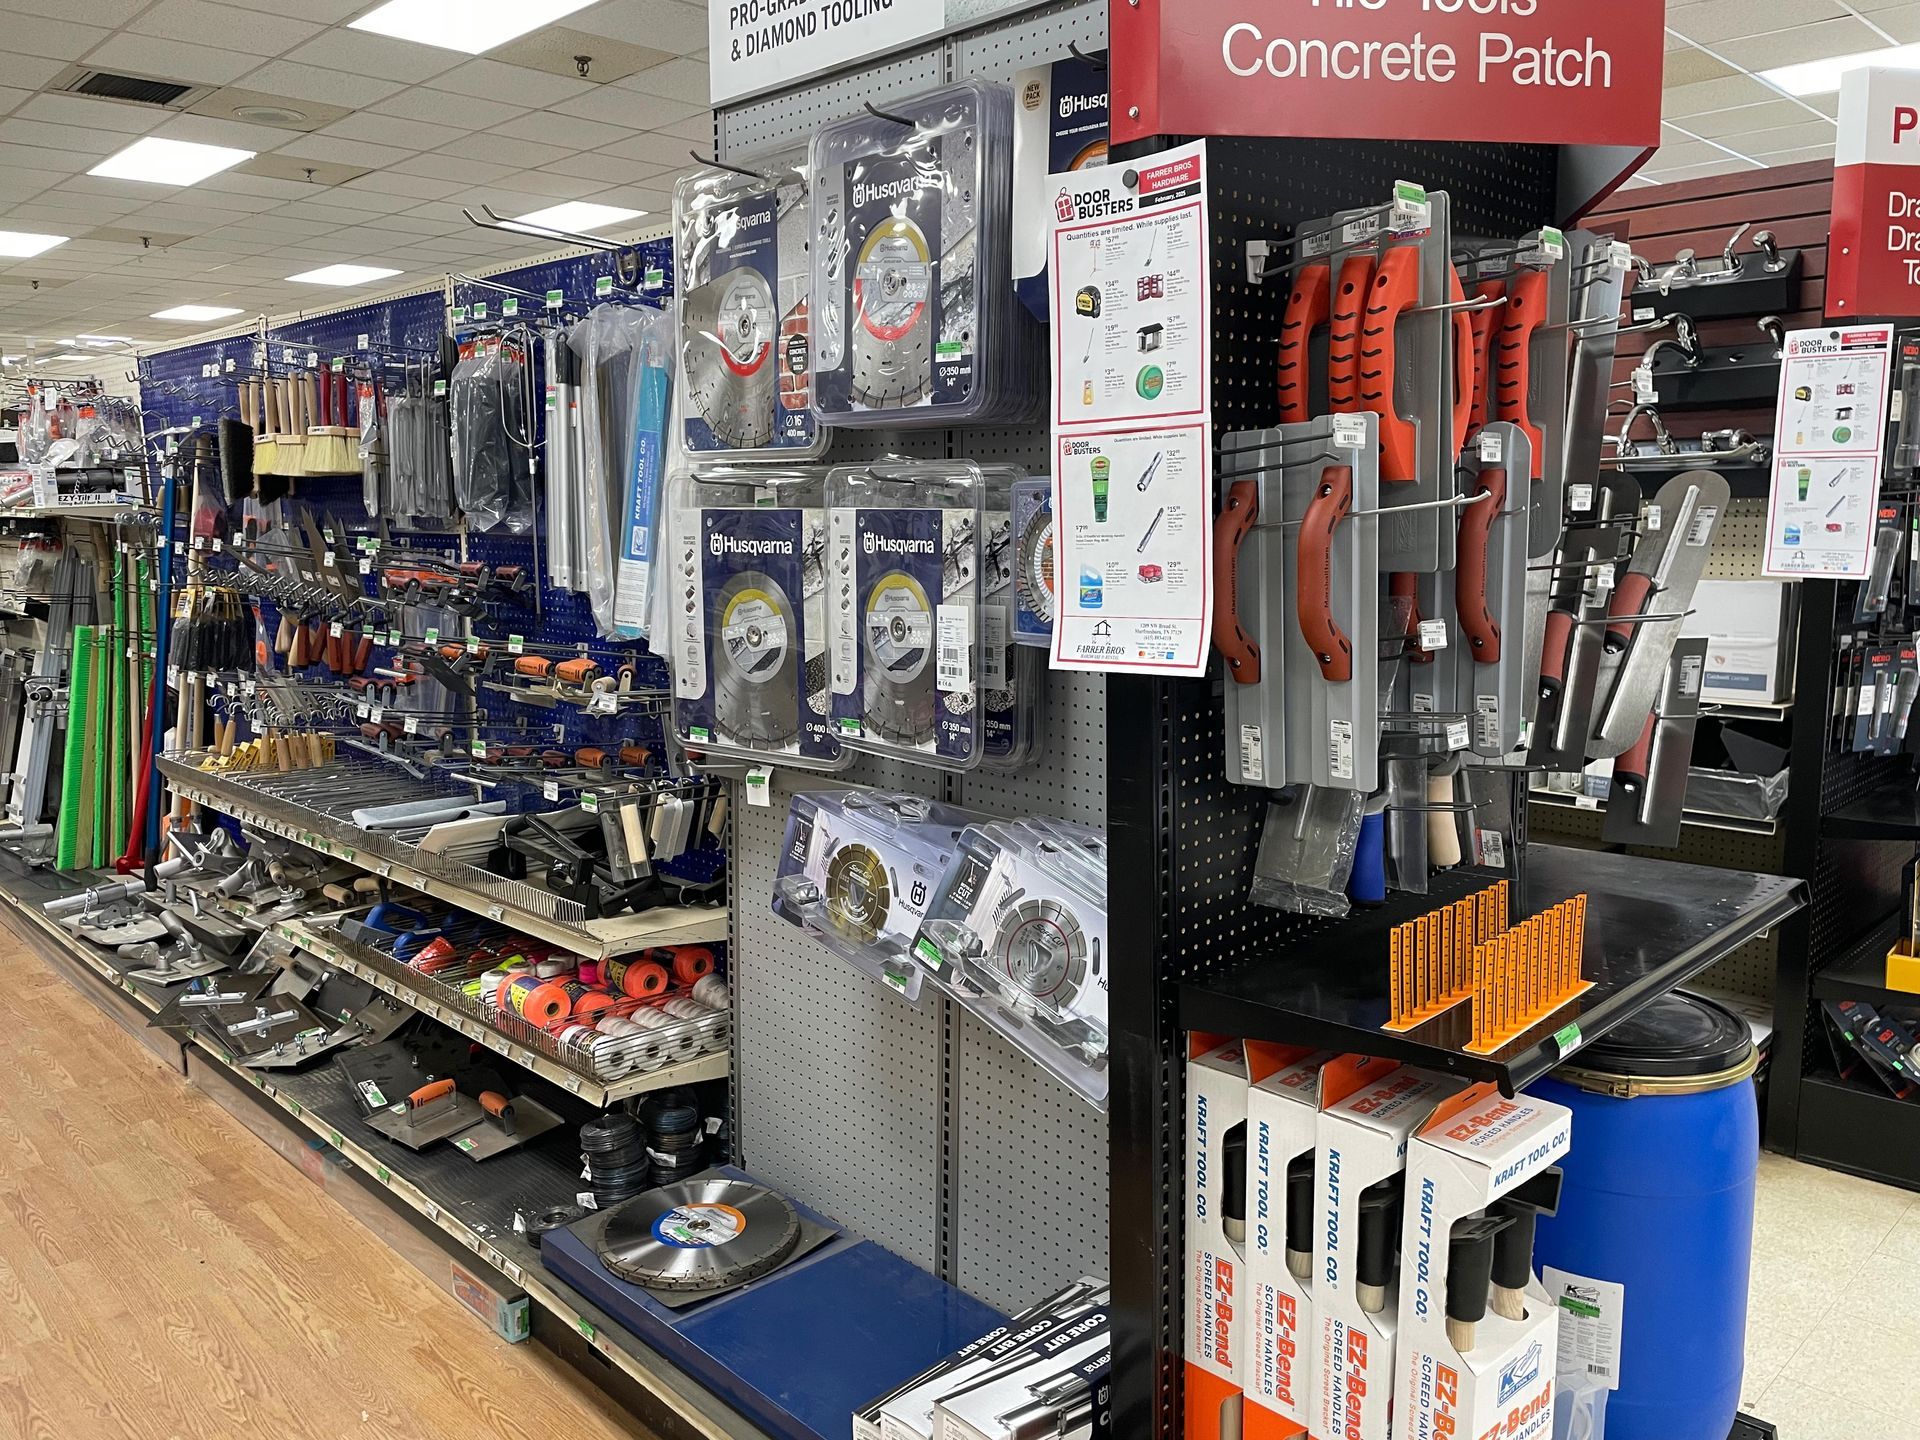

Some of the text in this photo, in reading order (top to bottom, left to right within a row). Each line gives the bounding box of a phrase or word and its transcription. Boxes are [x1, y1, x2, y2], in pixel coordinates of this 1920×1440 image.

[730, 0, 811, 30] PRO-GR
[731, 38, 741, 62] &
[747, 11, 816, 57] DIAMOND
[1221, 22, 1611, 88] Concrete Patch
[1026, 91, 1040, 100] PACK
[1027, 83, 1040, 92] NEW
[1893, 106, 1920, 144] P
[1146, 161, 1193, 180] FARRER BROS.
[866, 174, 933, 203] Husqvar
[1152, 173, 1189, 189] HARDWARE
[1074, 189, 1110, 206] DOOR
[1079, 198, 1133, 220] BUSTERS
[736, 210, 771, 230] sqvarna
[1066, 211, 1193, 241] Quantities are limited. While supplies last.
[1800, 340, 1823, 348] DOOR
[1801, 345, 1838, 354] BUSTERS
[1903, 345, 1919, 355] NEBO
[946, 366, 959, 376] 350
[793, 415, 805, 426] 16"
[787, 429, 797, 437] 400
[1072, 441, 1090, 449] DOOR
[1074, 447, 1101, 456] BUSTERS
[1878, 508, 1897, 518] NEBO
[724, 536, 792, 556] Husqvarna
[875, 533, 935, 555] Husqvarna
[1076, 644, 1104, 653] FARRER
[1106, 645, 1126, 655] BROS
[1872, 655, 1891, 663] NEBO
[1900, 650, 1916, 659] NEBO
[813, 724, 826, 734] 400
[949, 722, 960, 732] 350
[960, 726, 971, 734] mm
[986, 720, 999, 729] 350
[957, 886, 972, 900] CUT
[899, 898, 924, 918] Husqvar
[1371, 1100, 1402, 1119] SCREED
[1446, 1099, 1520, 1142] EZ-Bend
[1470, 1107, 1534, 1147] SCREED HANDLES
[1196, 1094, 1208, 1219] KRAFT TOOL CO.
[1494, 1132, 1567, 1188] KRAFT TOOL CO.
[1257, 1121, 1270, 1250] KRAFT TOOL CO.
[1326, 1148, 1341, 1283] KRAFT TOOL CO.
[1415, 1177, 1435, 1317] KRAFT TOOL CO.
[1204, 1252, 1212, 1359] SCREED HANDLES
[1215, 1257, 1234, 1369] EZ-Bend
[957, 1326, 1008, 1357] CORE BIT
[991, 1319, 1052, 1356] CORE BIT
[1043, 1313, 1107, 1352] CORE BIT
[1264, 1285, 1273, 1396] SCREED HANDLES
[1276, 1290, 1296, 1406] EZ-Bend
[1332, 1320, 1343, 1435] SCREED HANDLES
[1420, 1355, 1432, 1408] SCREED
[1100, 1410, 1111, 1426] C
